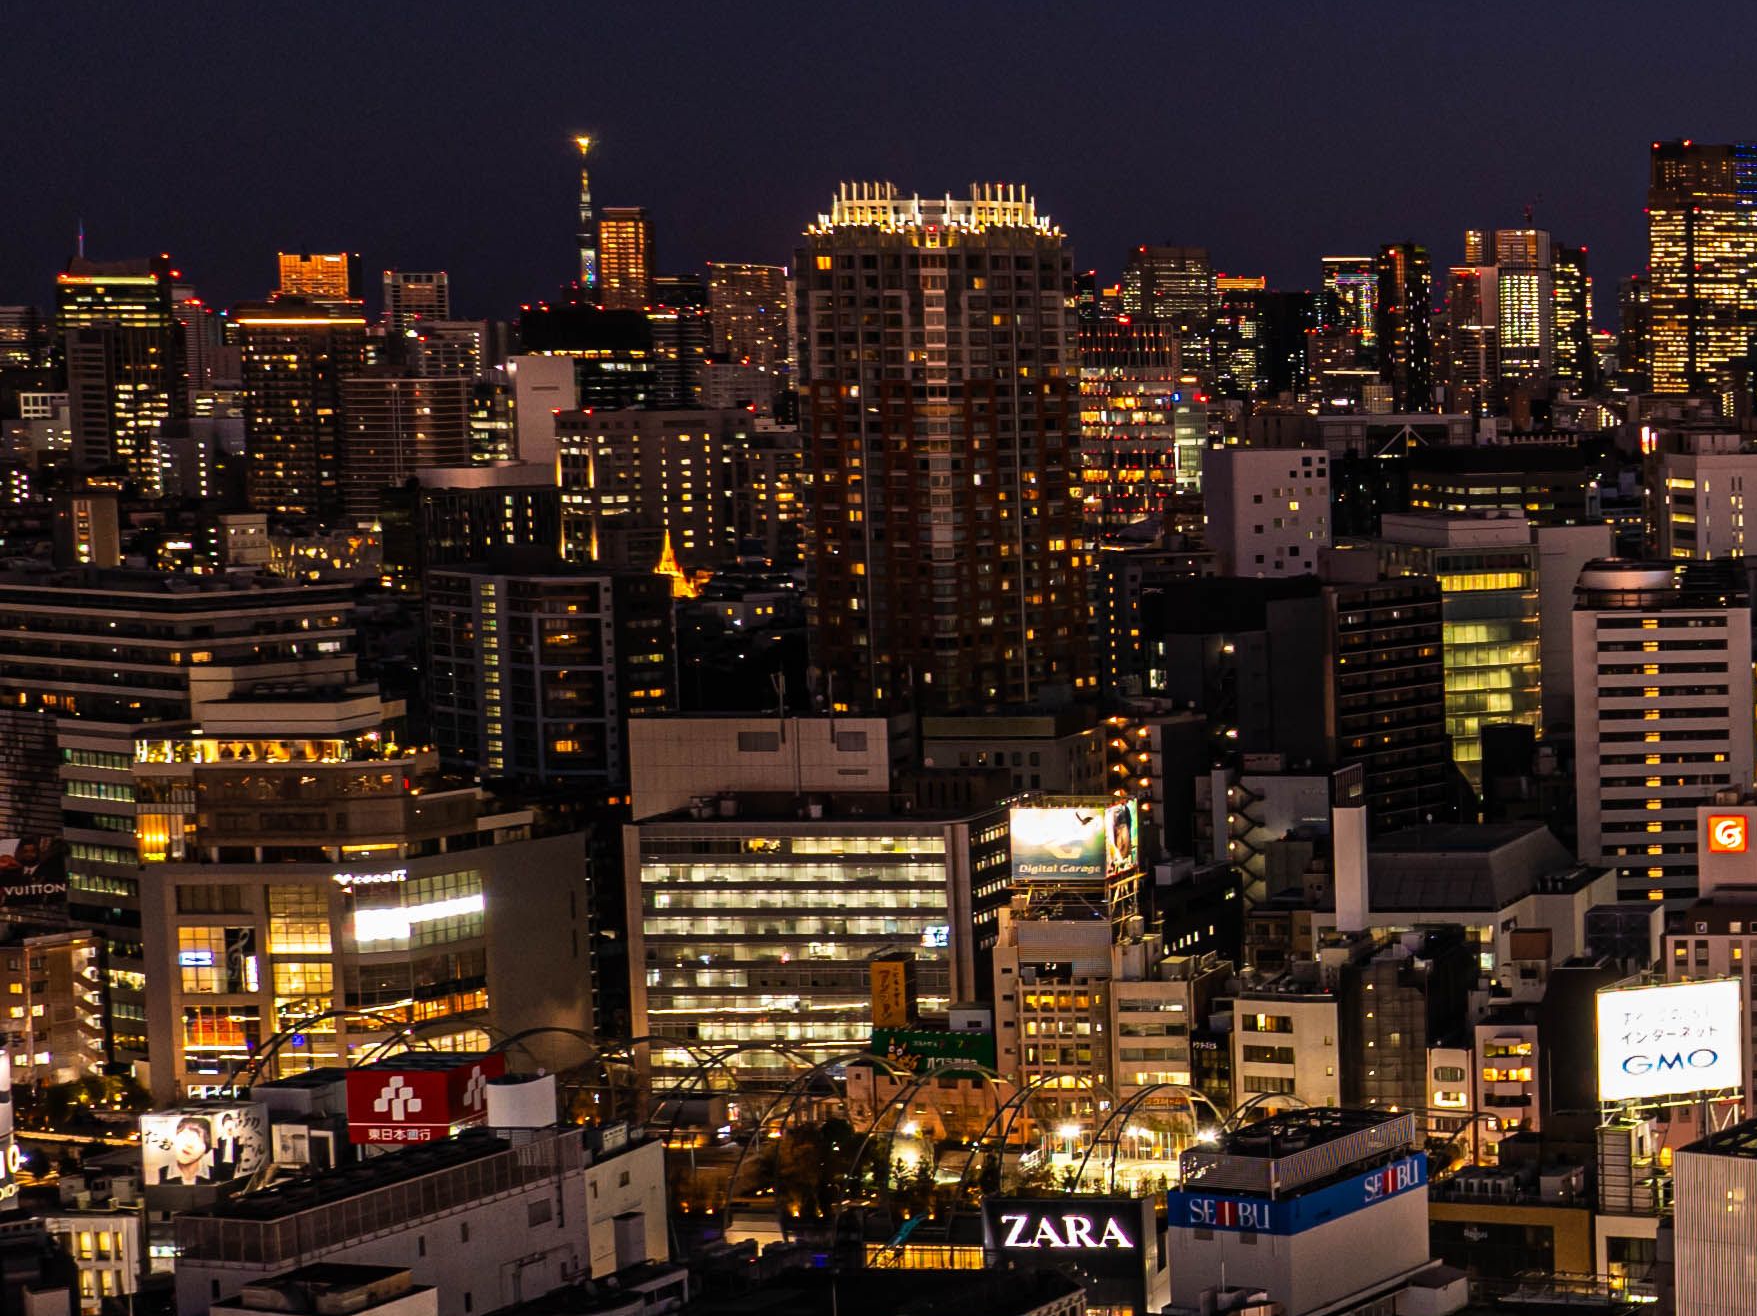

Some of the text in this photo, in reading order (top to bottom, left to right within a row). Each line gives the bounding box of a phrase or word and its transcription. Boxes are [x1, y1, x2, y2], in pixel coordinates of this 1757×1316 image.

[1019, 864, 1102, 875] Digital Garage
[3, 883, 67, 896] VUITTON
[1621, 1025, 1718, 1045] インターネット
[1622, 1048, 1718, 1075] GMO
[368, 1128, 431, 1141] 東日本銀行
[1364, 1159, 1419, 1203] SEIBU
[1189, 1198, 1270, 1229] SEIBU
[1001, 1213, 1134, 1248] ZARA
